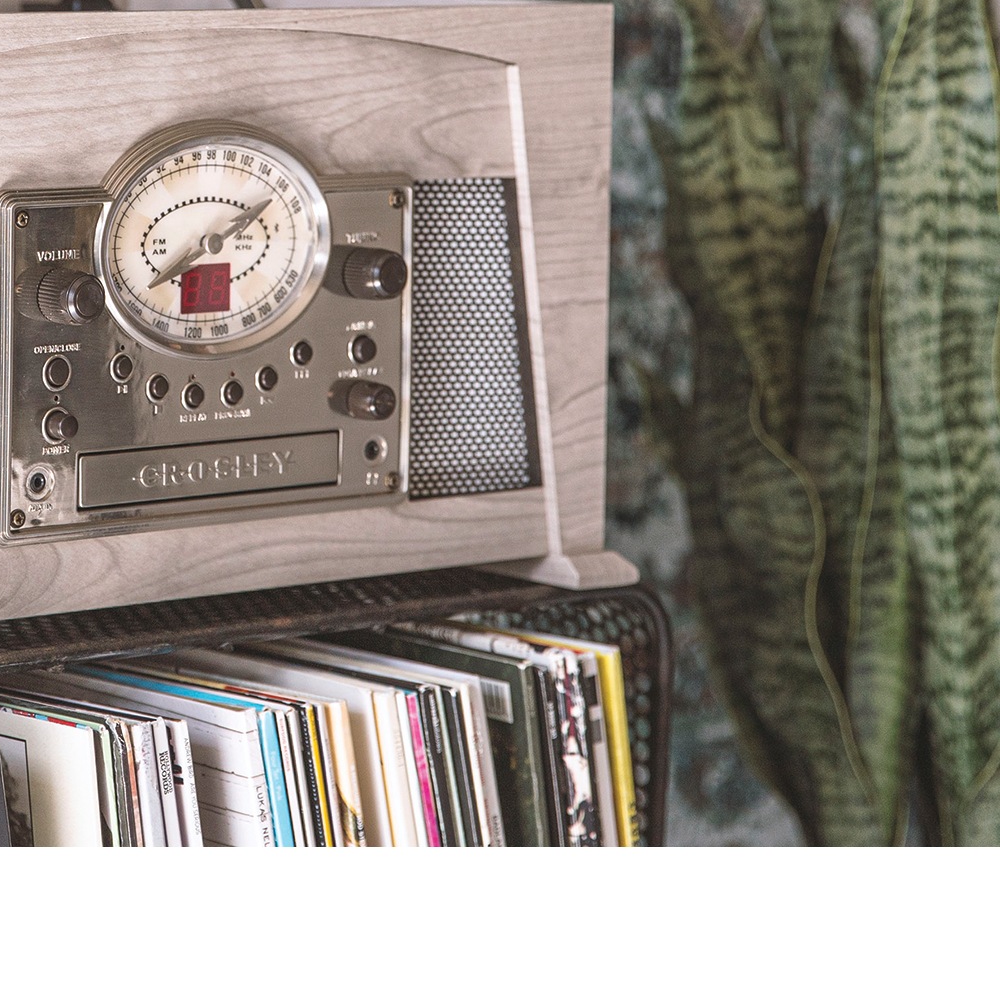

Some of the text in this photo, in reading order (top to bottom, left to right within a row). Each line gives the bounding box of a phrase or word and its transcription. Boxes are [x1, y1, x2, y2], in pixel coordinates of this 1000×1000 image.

[174, 156, 185, 166] 94
[192, 152, 202, 161] 96
[207, 150, 217, 160] 98
[223, 150, 237, 162] 100
[240, 154, 255, 168] 102
[258, 162, 272, 177] 104
[275, 176, 289, 192] 106
[290, 196, 302, 214] 108
[37, 249, 80, 262] VOLUME
[152, 318, 169, 333] 1400
[184, 327, 202, 339] 1200
[210, 324, 229, 337] 1000
[241, 313, 256, 327] 800
[257, 302, 271, 318] 700
[274, 286, 288, 303] 600
[285, 270, 298, 287] 530
[42, 444, 70, 456] POWER
[139, 450, 297, 488] CROSLEY
[158, 751, 170, 795] RECORDS
[164, 750, 174, 794] HOLLYWOOD
[255, 785, 268, 823] LUKAS
